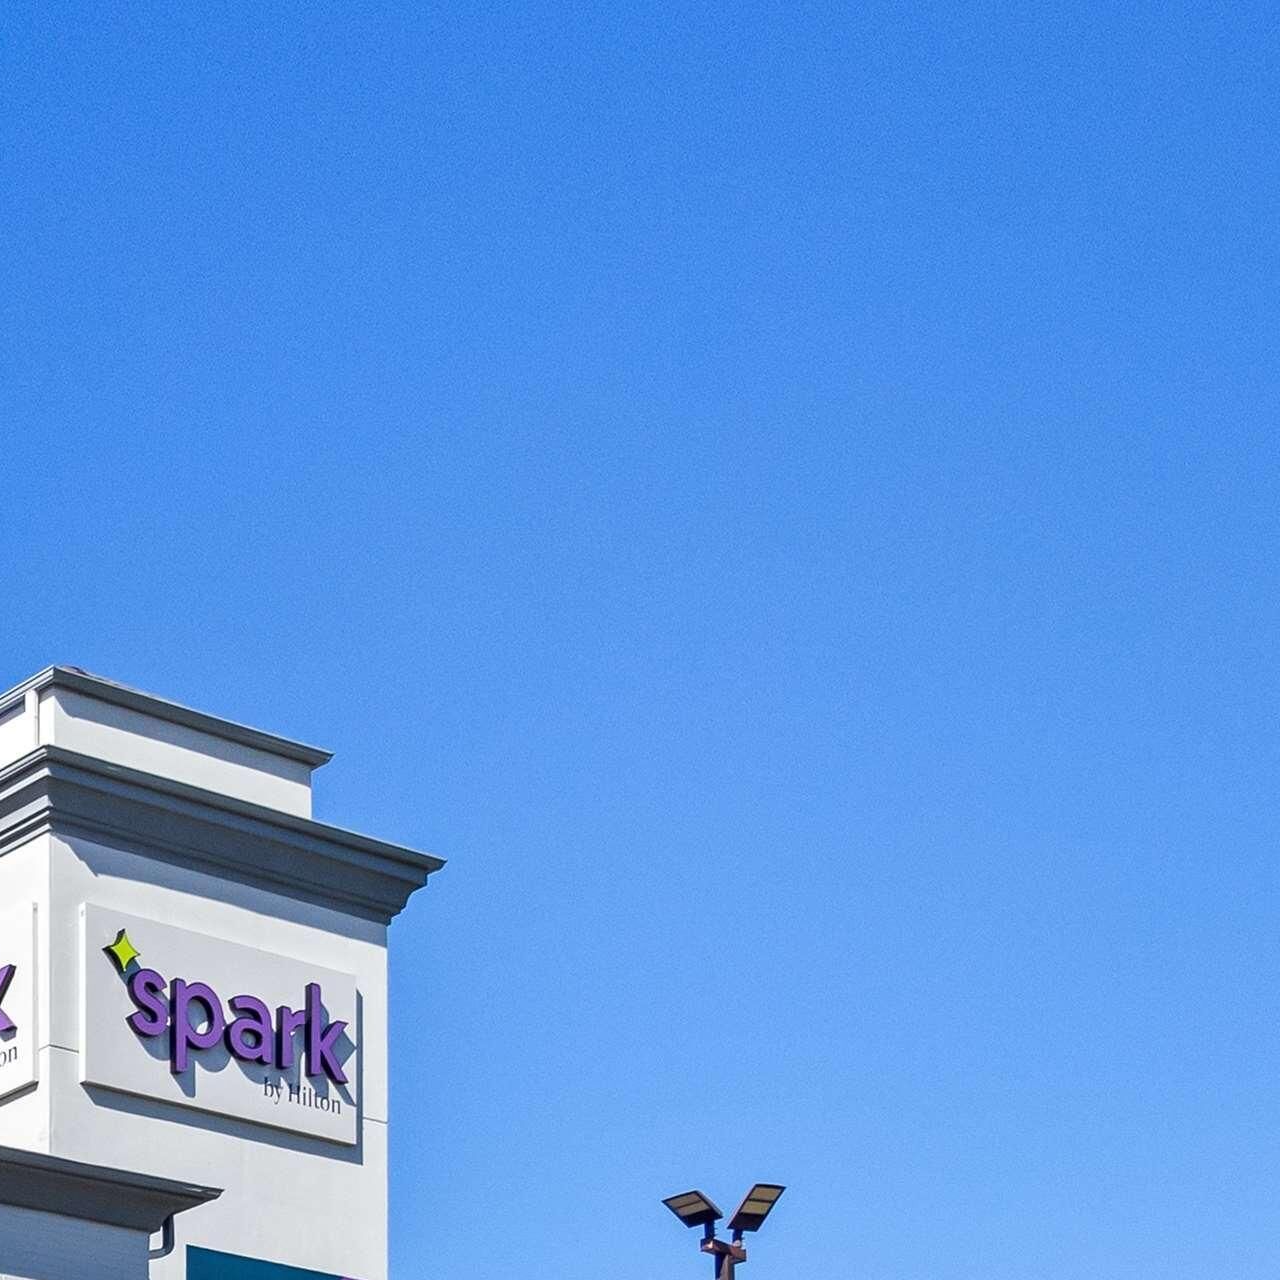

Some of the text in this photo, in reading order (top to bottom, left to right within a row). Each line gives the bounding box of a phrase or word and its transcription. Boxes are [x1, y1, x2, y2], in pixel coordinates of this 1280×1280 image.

[126, 968, 349, 1085] spark
[263, 1077, 342, 1115] by Hilton
